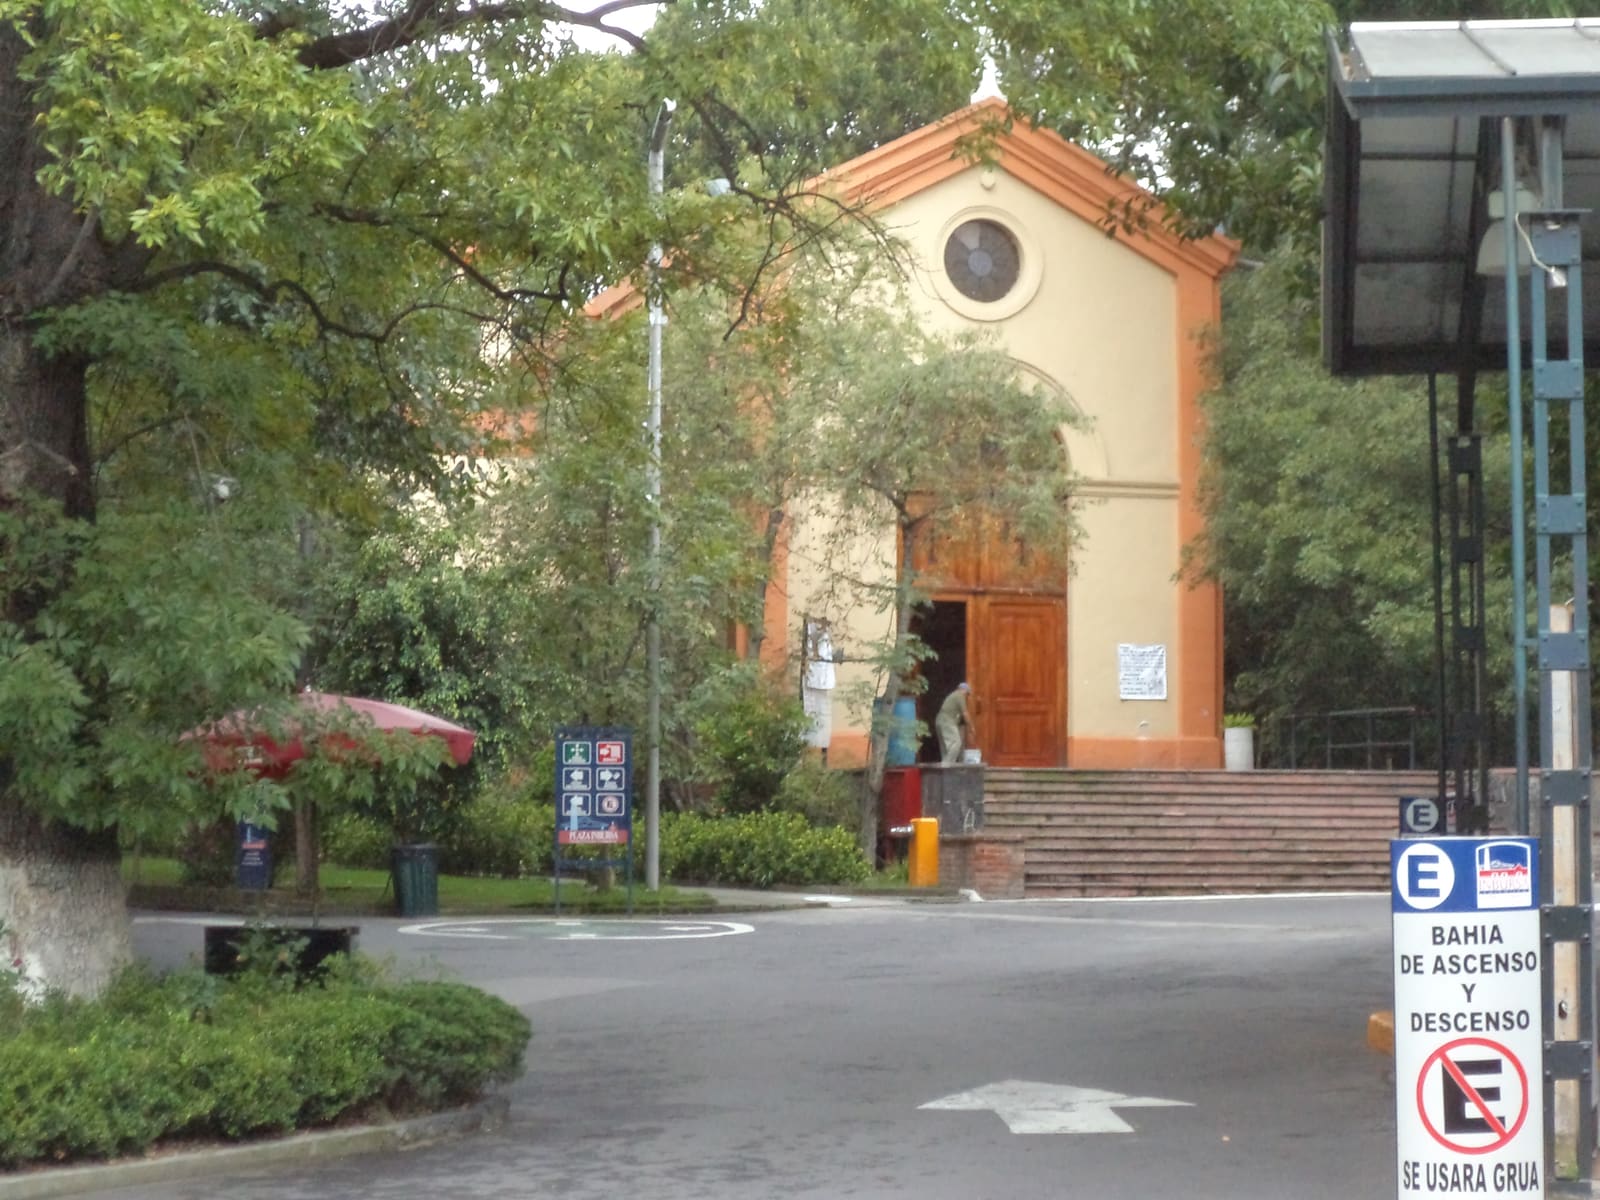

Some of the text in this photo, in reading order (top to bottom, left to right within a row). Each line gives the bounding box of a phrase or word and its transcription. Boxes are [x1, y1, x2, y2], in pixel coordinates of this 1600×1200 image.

[1413, 805, 1431, 826] E
[1408, 855, 1440, 897] E
[1431, 924, 1503, 945] BAHIA
[1401, 951, 1537, 975] DE ASCENSO
[1461, 983, 1476, 1003] Y
[1411, 1010, 1530, 1032] DESCENSO
[1441, 1059, 1505, 1134] E
[1403, 1160, 1539, 1193] SE USARA GRUA
